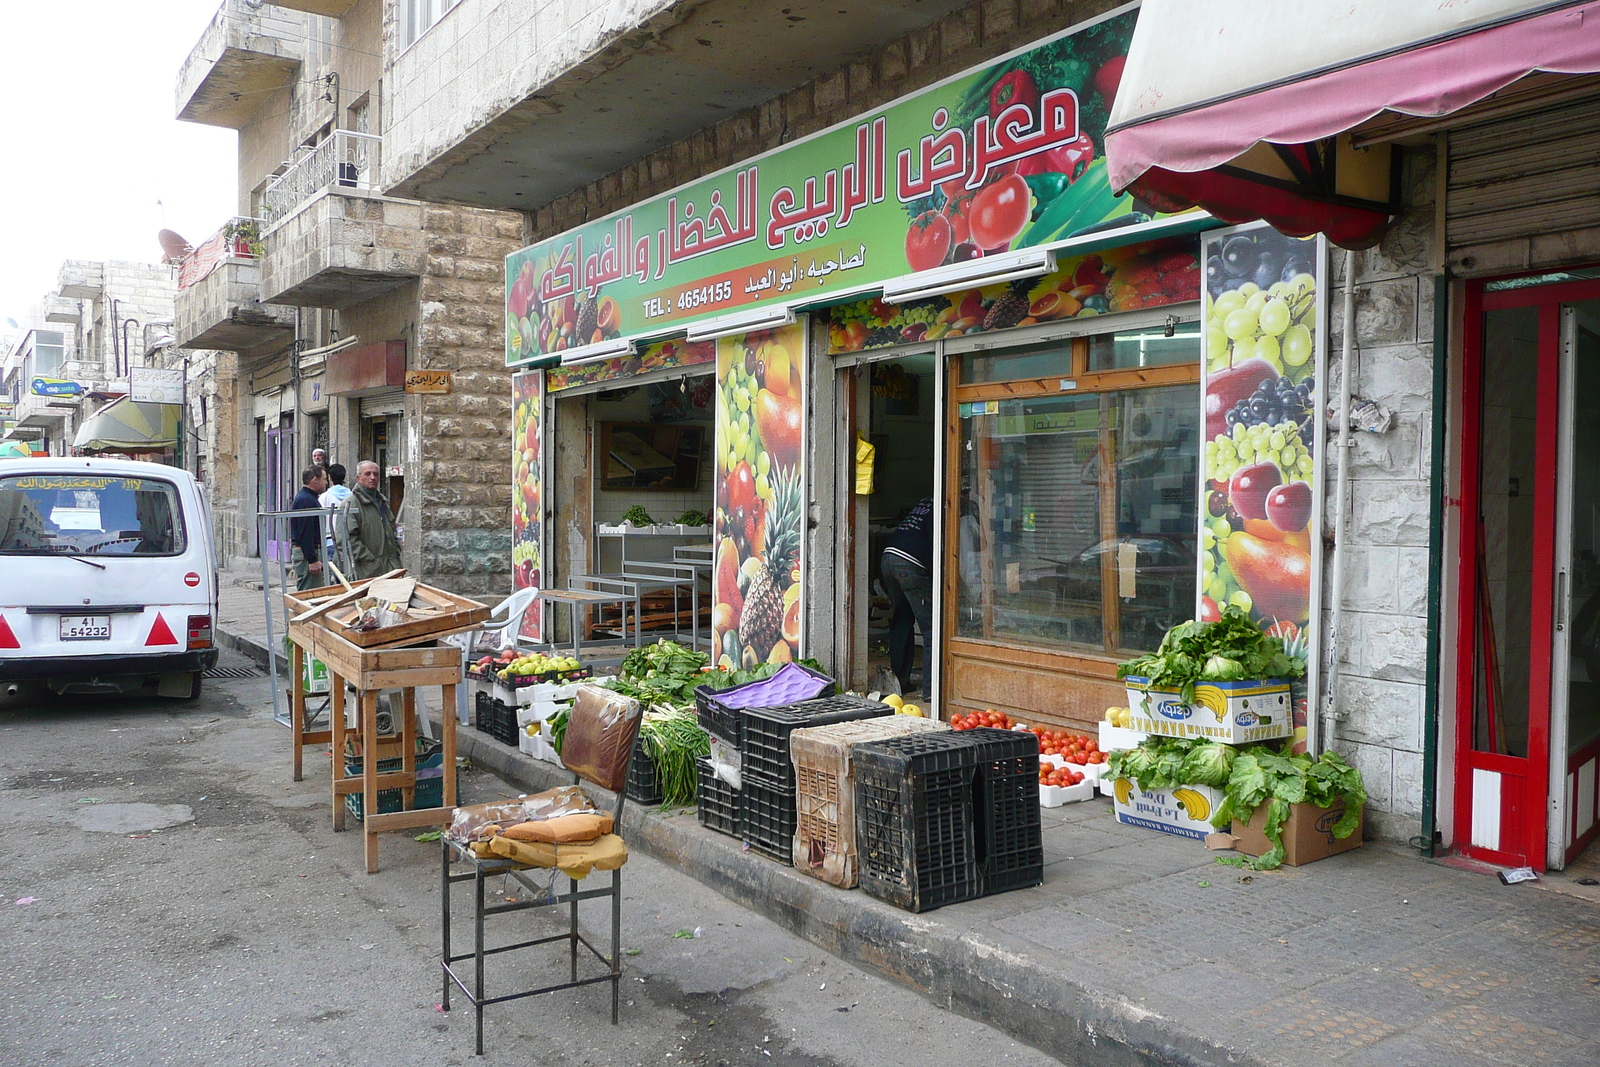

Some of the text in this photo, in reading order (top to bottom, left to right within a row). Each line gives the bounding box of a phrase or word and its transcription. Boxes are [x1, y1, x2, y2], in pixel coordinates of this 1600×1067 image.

[540, 85, 1081, 305] معرض الربيع للخضار والفواكه
[778, 255, 799, 292] أبو
[744, 267, 777, 300] العبد
[677, 280, 732, 310] 4654155
[16, 478, 38, 488] الله
[38, 477, 67, 490] رسول
[67, 477, 90, 488] محمد
[70, 627, 107, 636] 54232
[82, 617, 95, 627] 41
[1159, 700, 1192, 720] derby
[1130, 716, 1231, 738] PREMIUM BANANAS
[1243, 724, 1282, 742] BANANAS
[1136, 802, 1180, 821] Le Fruit
[1127, 816, 1200, 839] PREMIUM BANANAS
